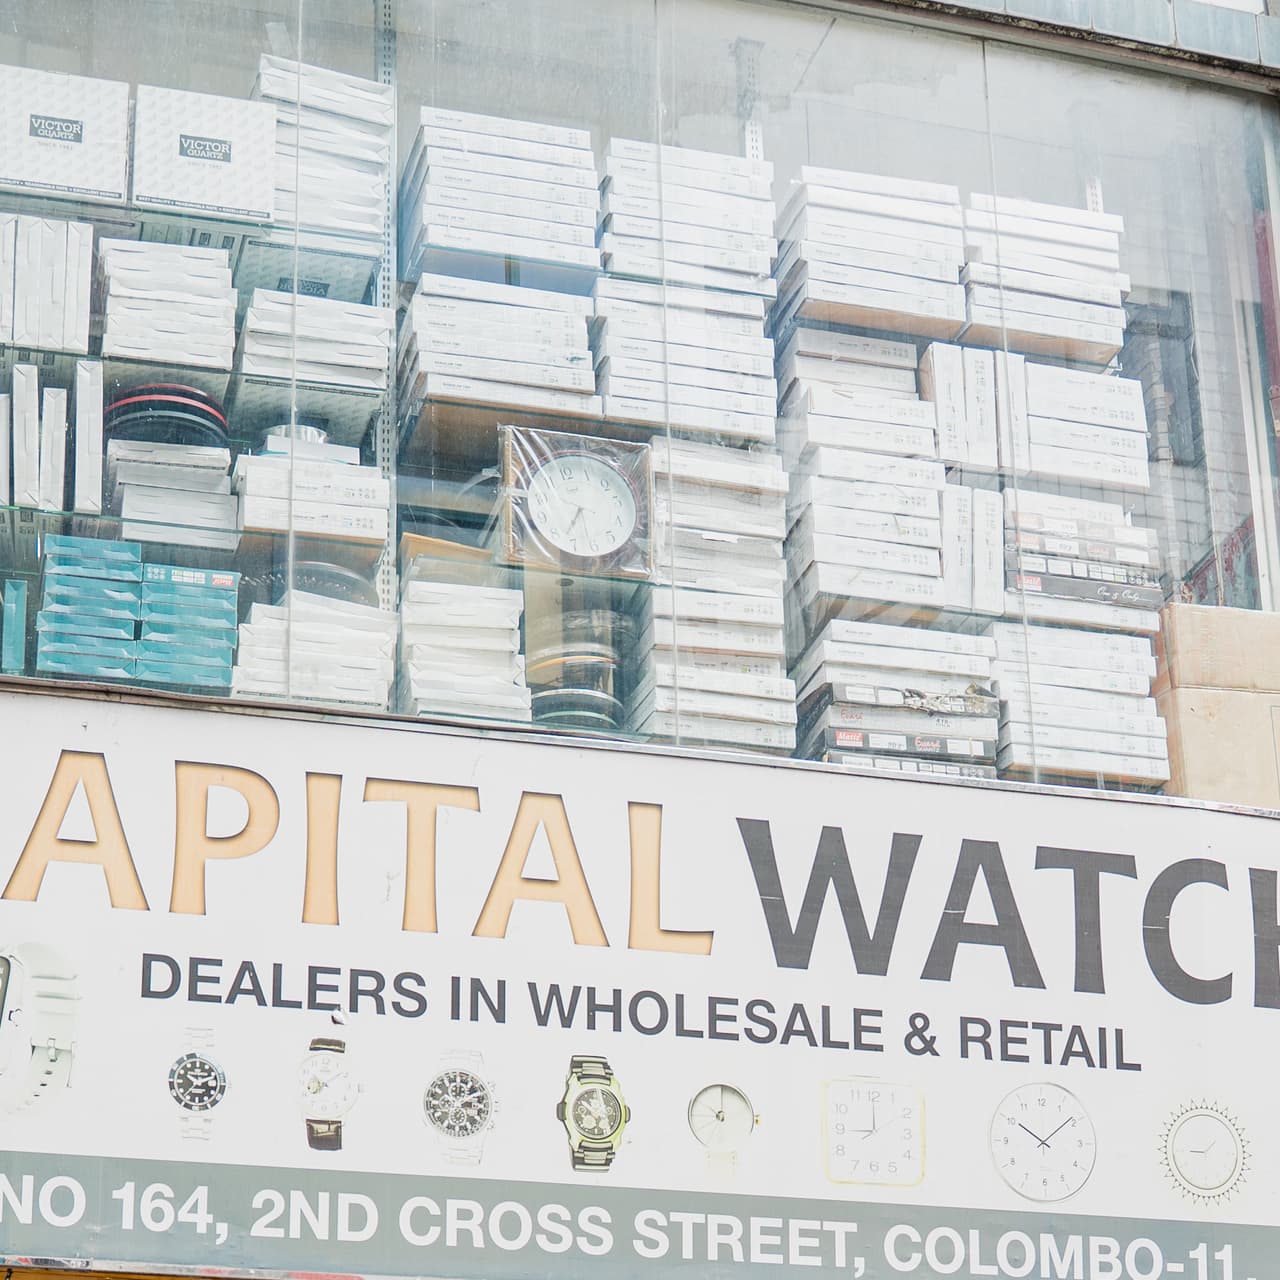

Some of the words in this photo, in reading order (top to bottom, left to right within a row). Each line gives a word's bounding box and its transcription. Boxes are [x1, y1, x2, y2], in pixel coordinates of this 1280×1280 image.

[31, 118, 81, 134] VICTOR
[38, 128, 75, 141] QUARTZ
[181, 138, 231, 154] VICTOR
[187, 149, 224, 160] QUARTZ
[141, 952, 427, 1020] DEALERS
[449, 976, 509, 1025] IN
[528, 983, 884, 1054] WHOLESALE
[903, 1011, 942, 1058] &
[960, 1015, 1142, 1073] RETAIL
[111, 1181, 228, 1246] 164,
[250, 1188, 380, 1242] 2ND
[398, 1197, 614, 1256] CROSS
[632, 1209, 866, 1280] STREET,
